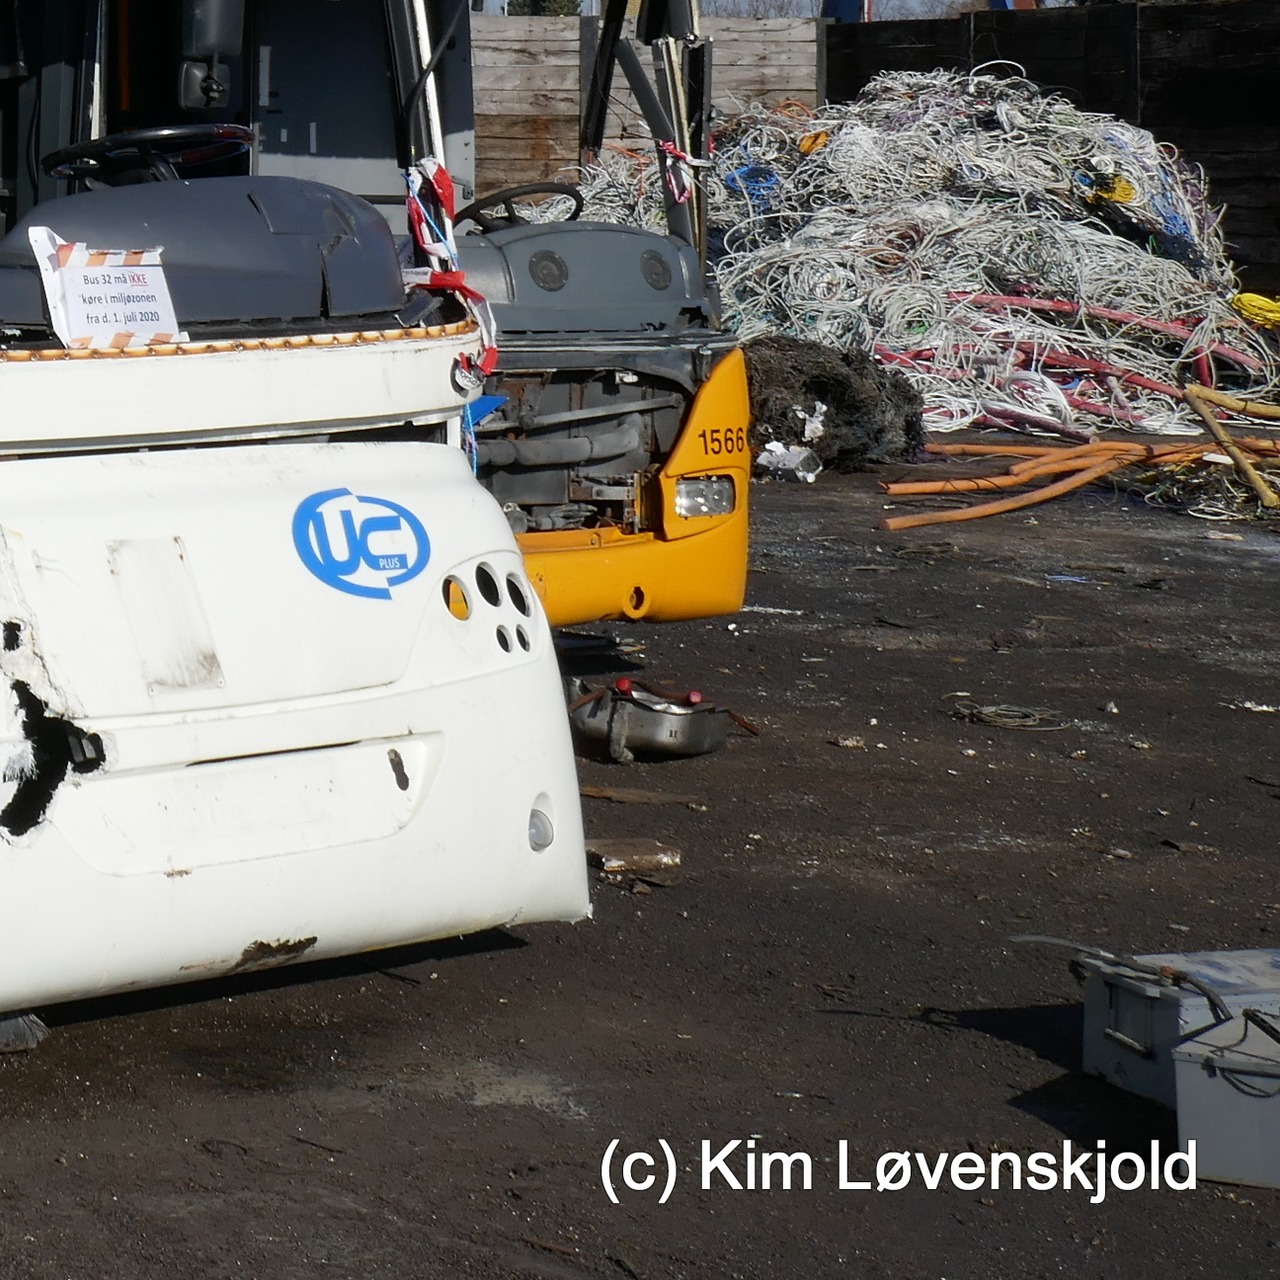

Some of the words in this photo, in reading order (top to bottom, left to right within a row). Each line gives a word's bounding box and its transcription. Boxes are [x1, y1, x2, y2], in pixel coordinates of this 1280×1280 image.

[83, 275, 100, 285] Bus
[101, 274, 112, 285] 32
[114, 272, 127, 284] må
[128, 273, 148, 285] IKKE
[81, 293, 103, 305] køre
[110, 292, 157, 306] miljøzonen
[86, 313, 100, 324] fra
[102, 312, 111, 323] d.
[123, 312, 138, 325] juli
[139, 311, 160, 322] 2020
[698, 427, 744, 455] 1566
[378, 557, 401, 569] PLUS
